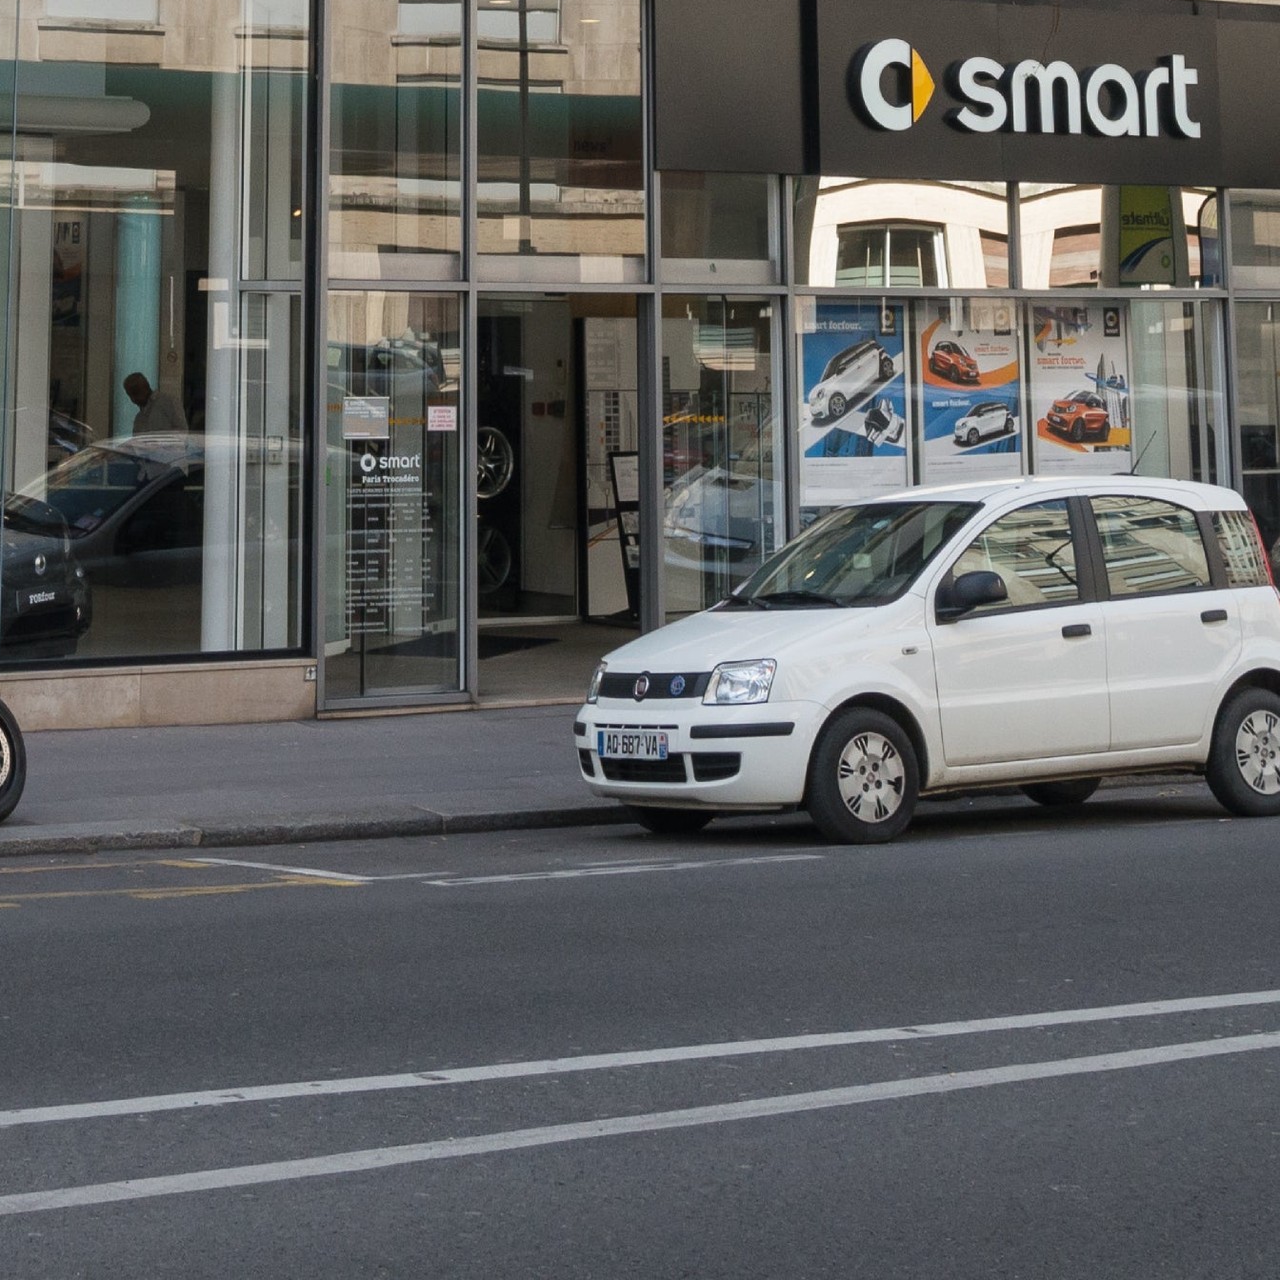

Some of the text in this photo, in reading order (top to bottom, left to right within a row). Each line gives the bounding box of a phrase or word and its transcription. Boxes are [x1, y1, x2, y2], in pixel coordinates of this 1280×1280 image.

[957, 53, 1201, 138] smart
[379, 454, 421, 469] smart
[362, 475, 381, 484] Paris
